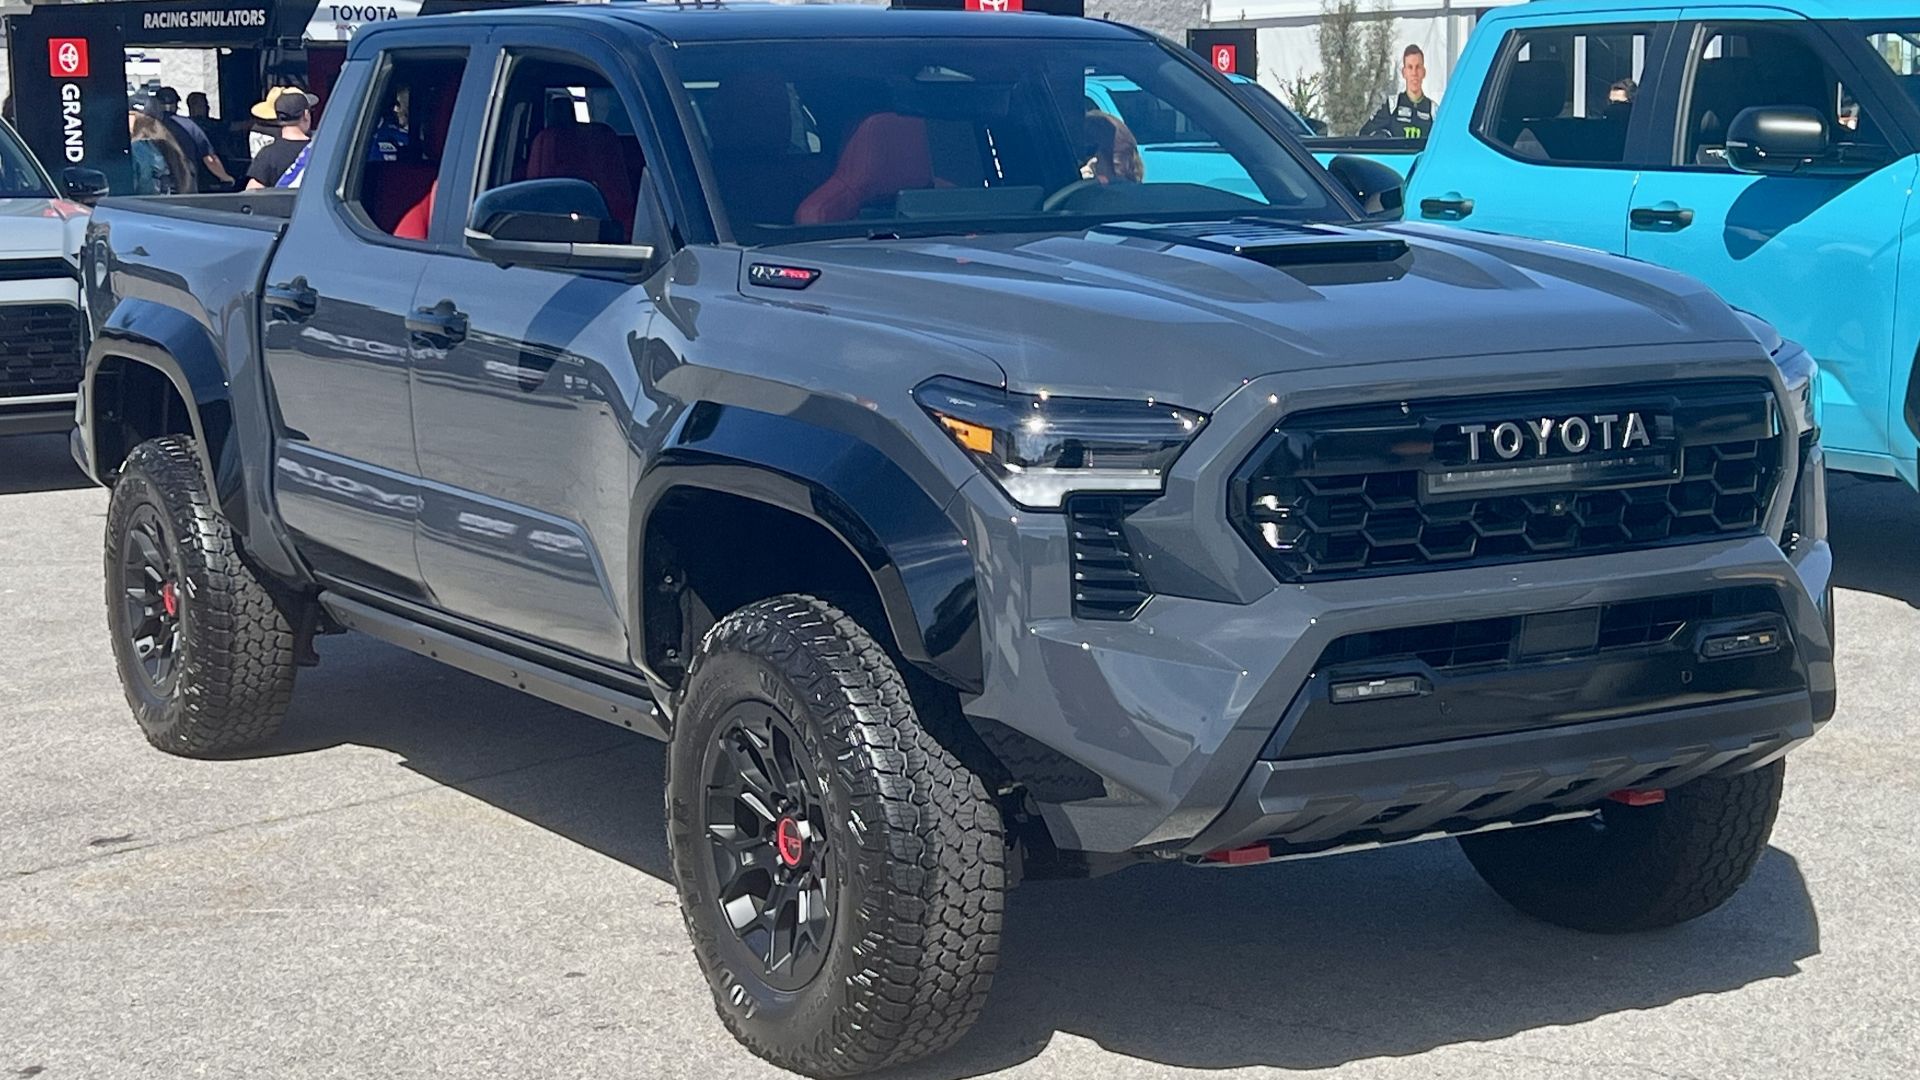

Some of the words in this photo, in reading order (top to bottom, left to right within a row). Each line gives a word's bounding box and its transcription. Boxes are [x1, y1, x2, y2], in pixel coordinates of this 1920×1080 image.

[143, 11, 189, 29] RACING
[189, 9, 265, 28] SIMULATORS
[329, 5, 398, 21] TOYOTA
[61, 83, 84, 163] GRAND
[1461, 412, 1650, 461] TOYOTA
